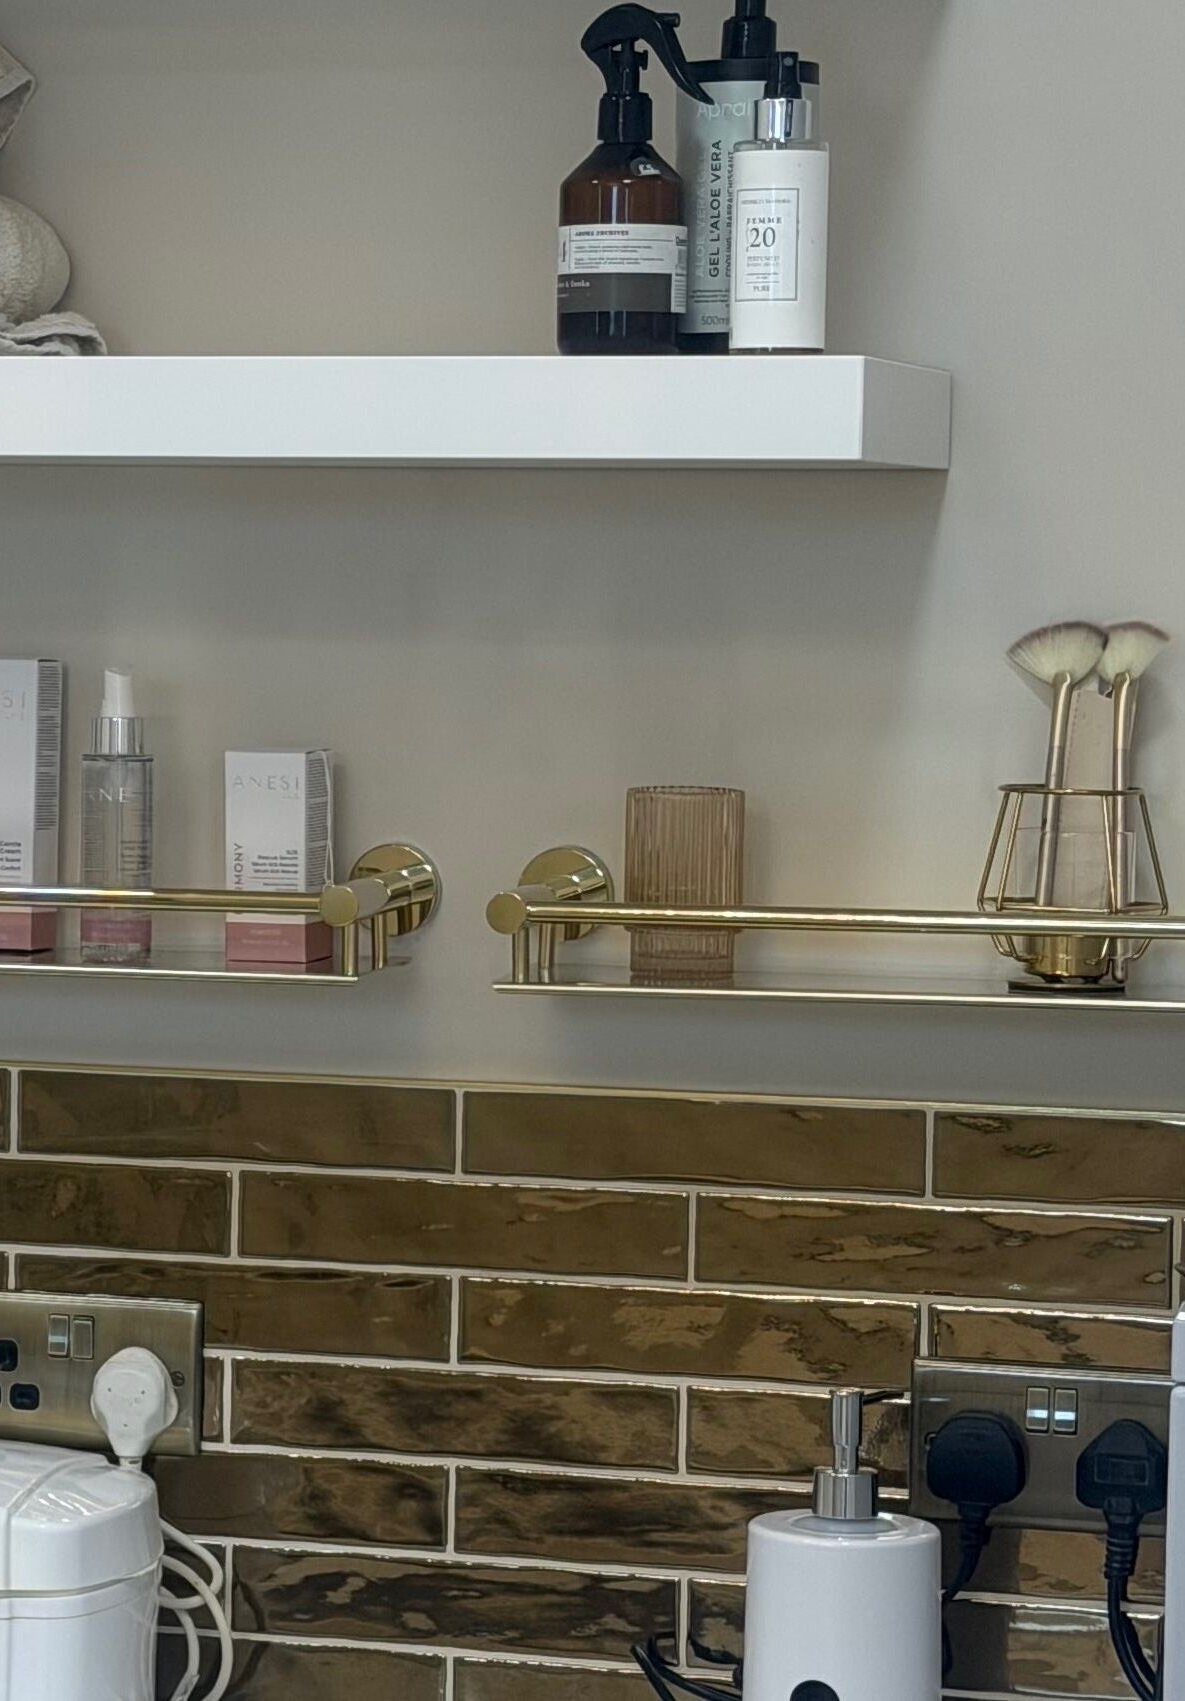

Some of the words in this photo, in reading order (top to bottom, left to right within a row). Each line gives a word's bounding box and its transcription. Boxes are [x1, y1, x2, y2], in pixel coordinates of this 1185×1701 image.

[710, 139, 722, 183] VERA
[709, 187, 721, 242] L'ALOE
[746, 217, 782, 225] FEMME
[749, 227, 776, 248] 20
[709, 248, 720, 278] GEL
[233, 775, 299, 791] ANESI
[233, 843, 244, 888] MONY
